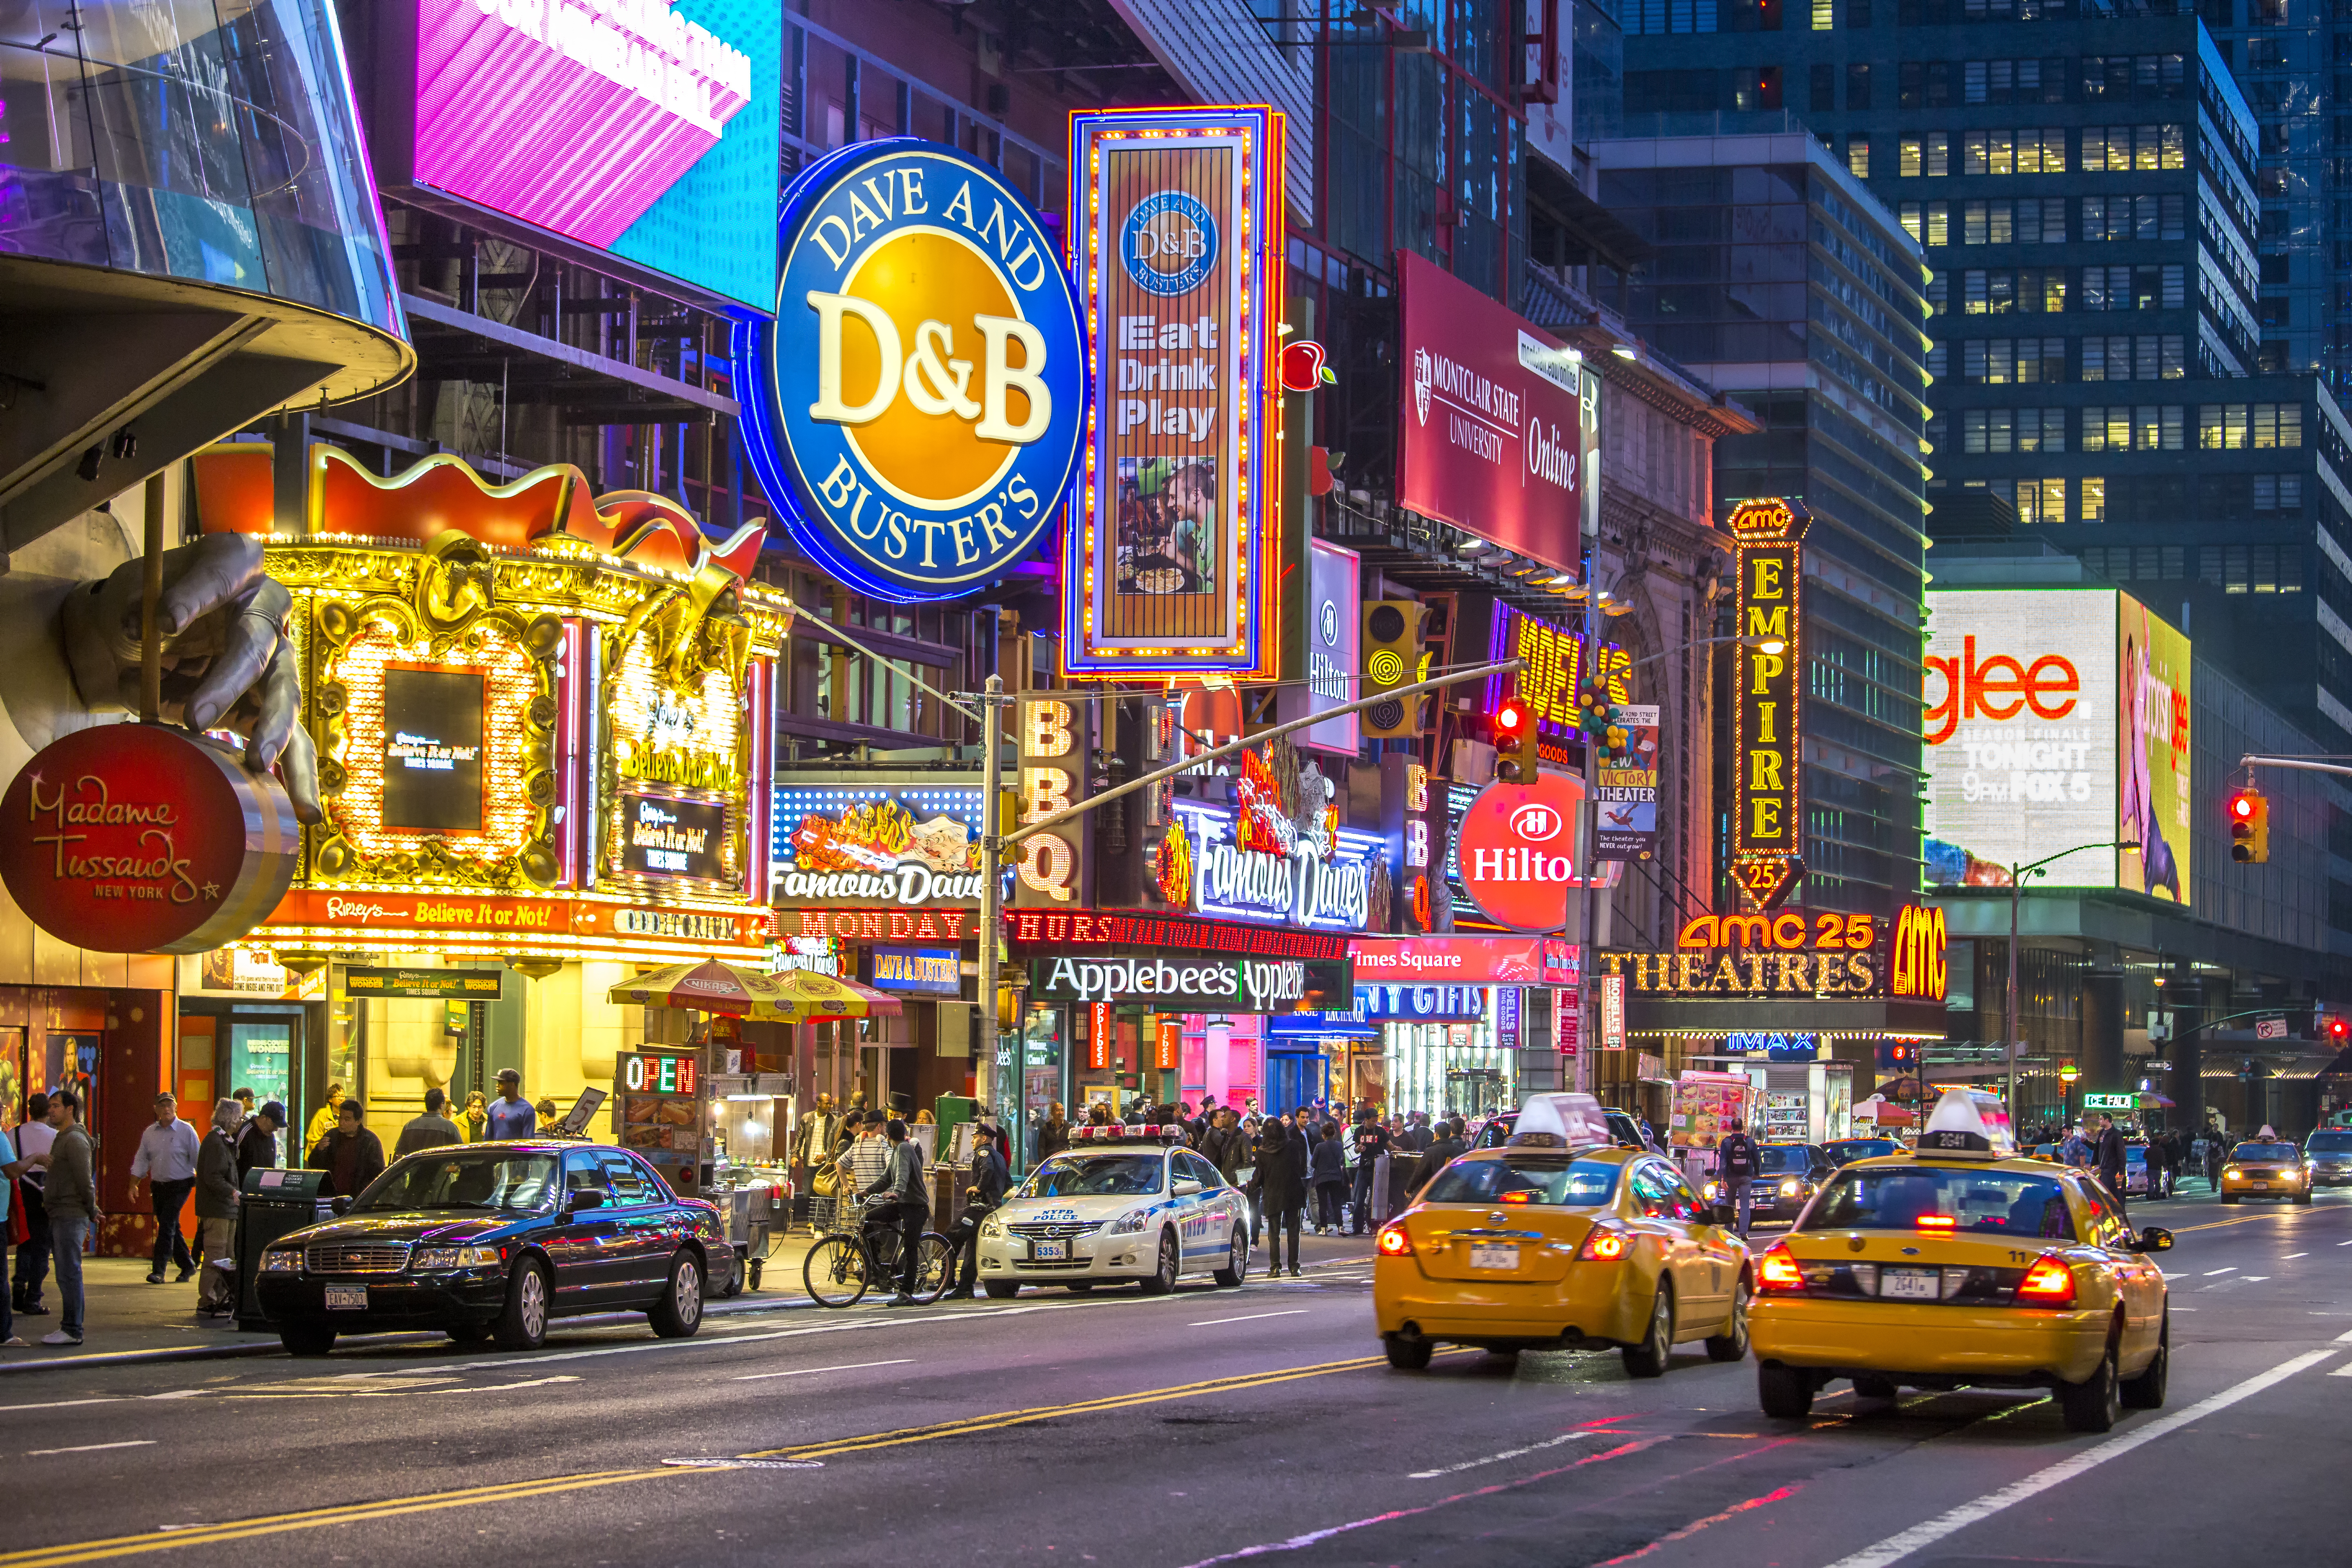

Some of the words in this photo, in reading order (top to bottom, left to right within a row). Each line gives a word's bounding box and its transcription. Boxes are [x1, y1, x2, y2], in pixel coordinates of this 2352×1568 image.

[1133, 197, 1170, 225] DAVE
[1175, 197, 1207, 223] AND
[810, 168, 928, 272] DAVE
[943, 180, 1045, 291] AND
[1132, 229, 1207, 261] D&B
[1135, 265, 1205, 293] BUSTER'S
[1119, 316, 1217, 351] Eat
[807, 290, 1052, 443] D&B
[1119, 358, 1216, 392] Drink
[1433, 353, 1491, 413] MONTCLAIR
[1493, 384, 1519, 427] STATE
[1118, 399, 1216, 441] Play
[1450, 413, 1503, 465] UNIVERSITY
[1529, 416, 1575, 492] Online
[818, 454, 1039, 568] BUSTER'S
[1310, 652, 1349, 702] Hilton
[1747, 558, 1788, 838] EMPIRE
[629, 739, 678, 781] Believe
[694, 760, 708, 787] or
[1539, 743, 1568, 764] GOODS
[1961, 744, 2091, 770] TONIGHT
[1601, 770, 1653, 786] VICTORY
[2010, 773, 2065, 802] FOX
[2070, 773, 2091, 802] 5
[29, 775, 178, 825] Madame
[1018, 700, 1071, 901] BBQ
[1599, 787, 1655, 802] THEATER
[1617, 843, 1642, 852] outgrow!
[33, 830, 197, 903] Tussauds
[1196, 813, 1292, 913] Famous
[1296, 839, 1368, 928] Dave's
[1474, 847, 1597, 882] Hilto
[1748, 866, 1775, 889] 25
[95, 884, 125, 898] NEW
[129, 886, 164, 900] YORK
[768, 862, 899, 908] Famous
[415, 902, 472, 924] Believe
[476, 904, 492, 924] It
[494, 907, 513, 925] or
[515, 905, 552, 927] Not!
[627, 909, 736, 940] ODDITORIUM
[799, 912, 965, 939] MONDAY
[1816, 914, 1873, 950] 25
[875, 953, 903, 980] DAVE
[904, 962, 913, 980] &
[914, 952, 958, 983] BUSTER'S
[1347, 950, 1397, 967] Times
[1400, 951, 1461, 971] Square
[1545, 953, 1559, 968] Hilton
[1558, 954, 1571, 969] Times
[1599, 952, 1874, 993] THEATRES
[234, 982, 245, 991] COME
[245, 982, 257, 991] INSIDE
[267, 983, 275, 992] FIND
[276, 984, 284, 992] OUT!
[392, 978, 421, 988] Believe
[422, 979, 429, 988] It
[440, 979, 457, 989] Not!
[691, 980, 730, 991] NIKAS
[1046, 958, 1238, 1002] Applebee's
[725, 1002, 746, 1011] Dogs
[776, 1000, 793, 1009] NIKAS
[824, 1000, 842, 1010] NIKAS
[1610, 978, 1621, 1034] MODELL'S
[247, 1045, 289, 1054] WONDER
[1728, 1032, 1815, 1050] IMAX
[1897, 1049, 1903, 1058] 3
[626, 1056, 695, 1093] OPEN
[1186, 1214, 1207, 1238] NYPD
[1037, 1246, 1059, 1256] 5353
